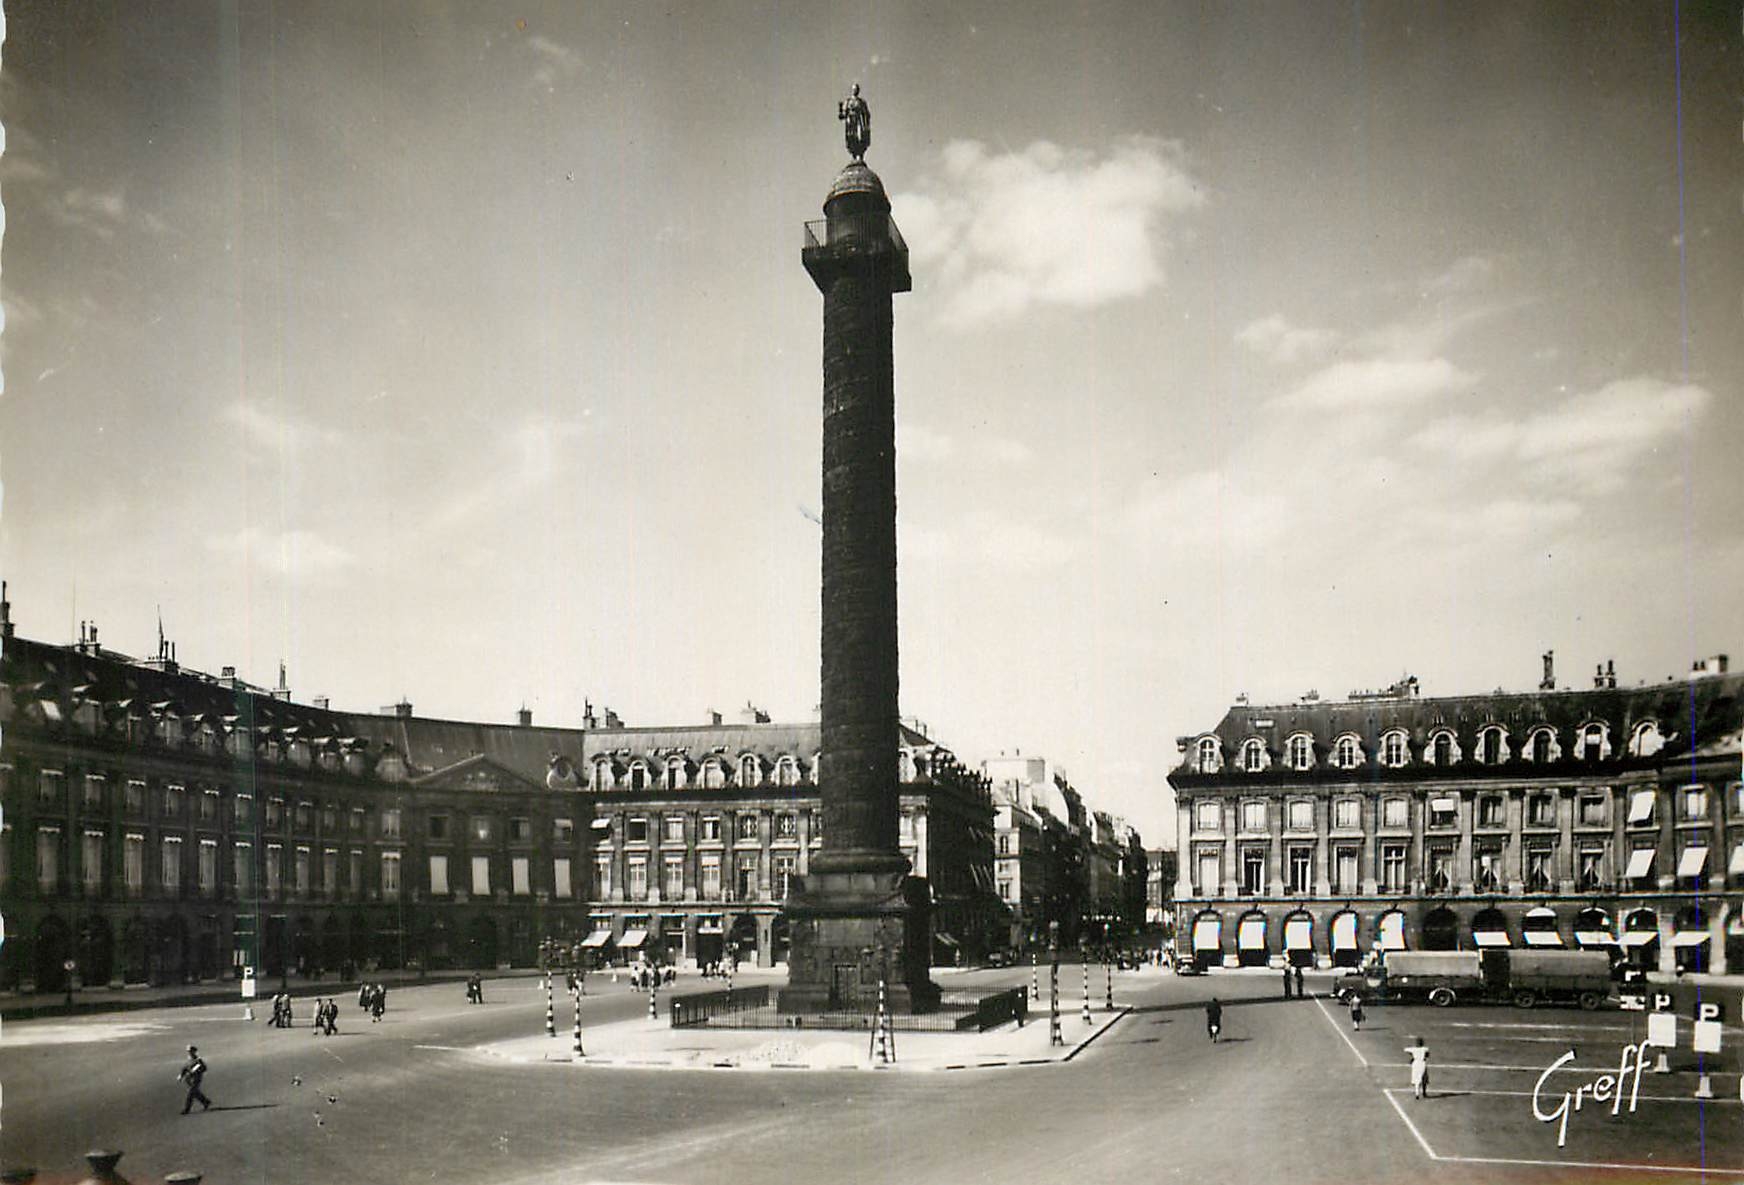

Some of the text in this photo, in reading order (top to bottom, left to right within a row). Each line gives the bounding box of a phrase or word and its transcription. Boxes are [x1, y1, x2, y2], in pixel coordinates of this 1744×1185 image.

[244, 967, 253, 980] P
[1655, 994, 1670, 1010] P
[1700, 1003, 1719, 1022] P
